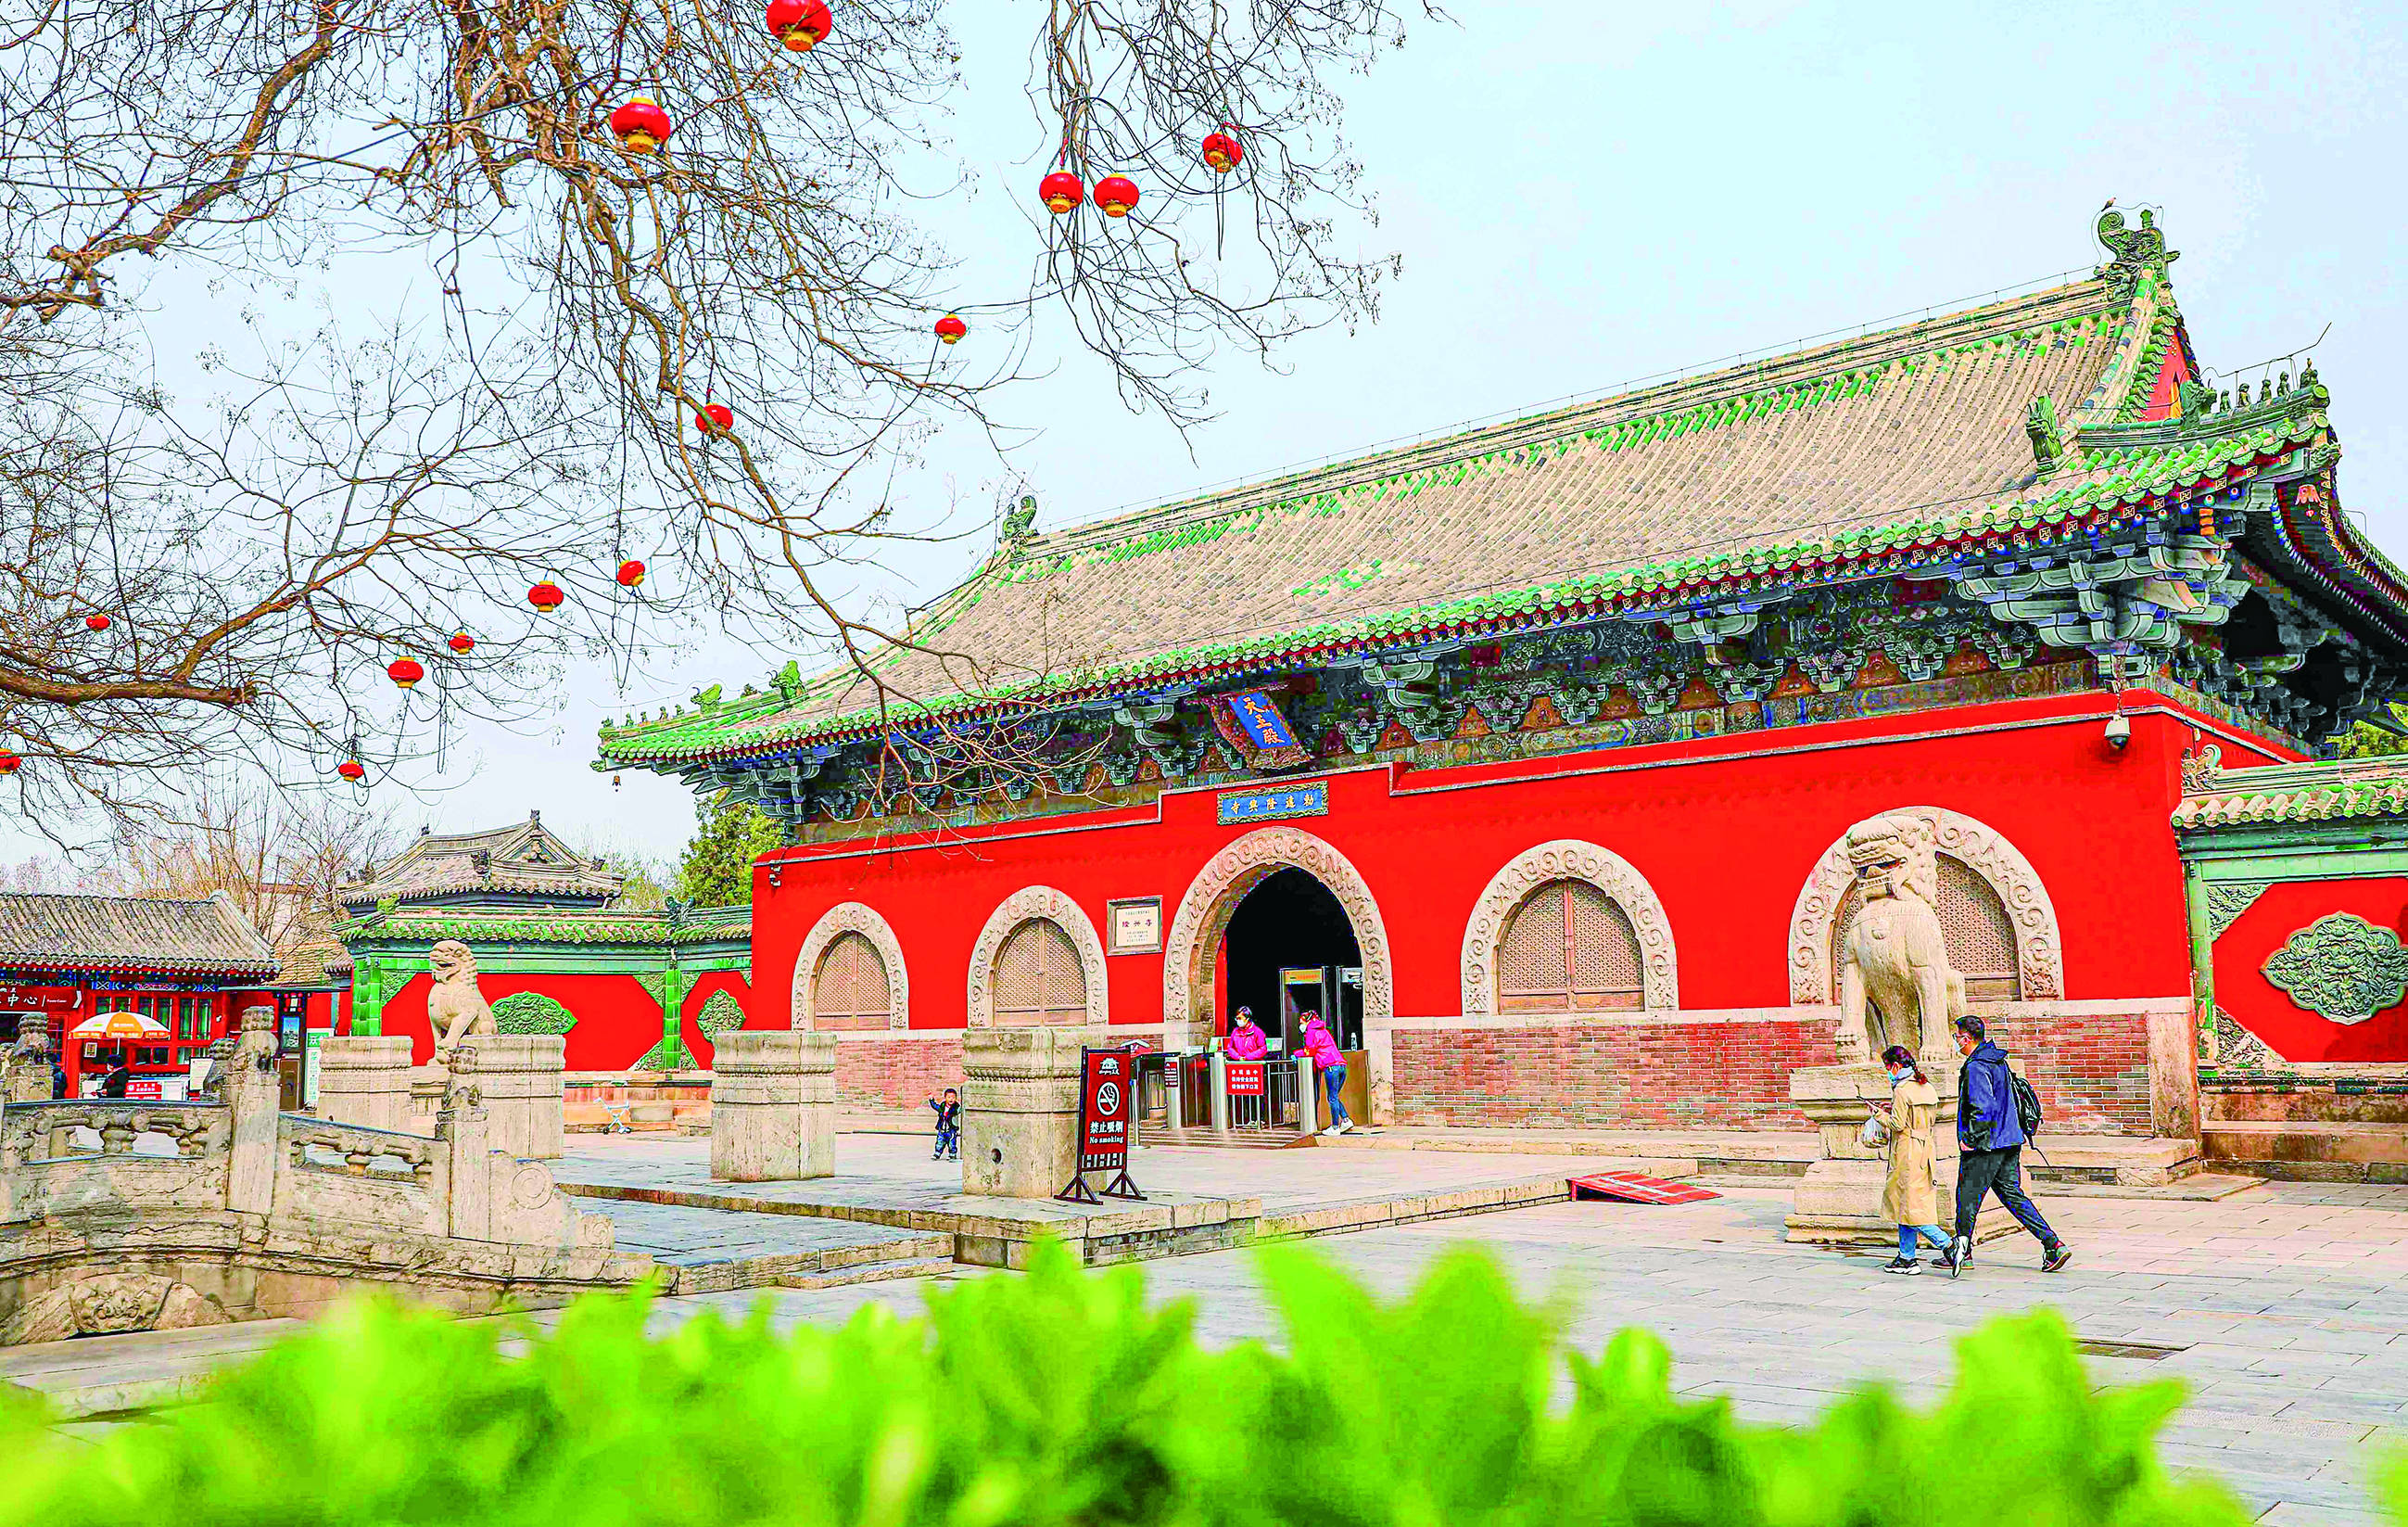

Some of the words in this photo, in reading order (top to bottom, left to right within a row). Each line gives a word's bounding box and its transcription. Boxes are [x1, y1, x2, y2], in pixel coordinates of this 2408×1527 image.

[1243, 696, 1286, 744] 天王殿
[0, 993, 38, 1007] 中心
[1098, 1136, 1124, 1144] smoking
